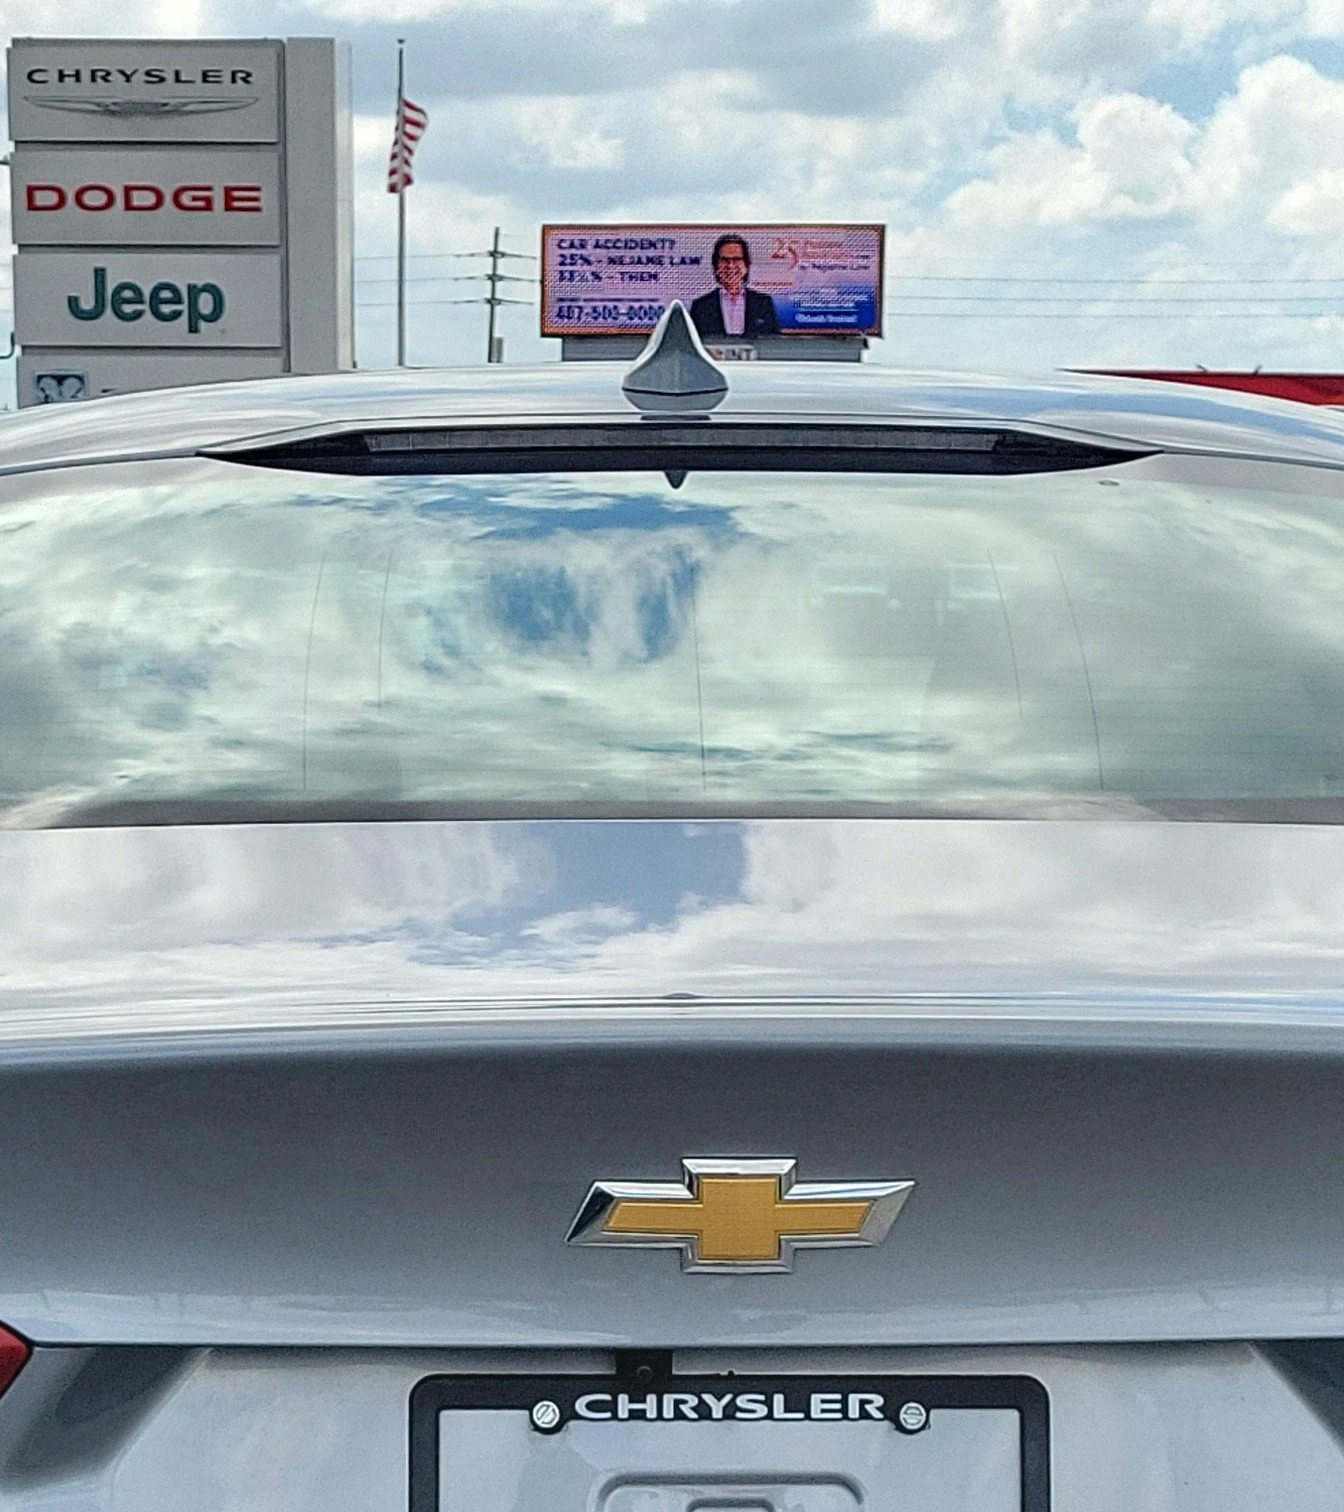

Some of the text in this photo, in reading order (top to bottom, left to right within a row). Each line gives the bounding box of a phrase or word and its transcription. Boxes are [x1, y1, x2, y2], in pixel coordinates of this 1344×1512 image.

[26, 68, 254, 85] CHRYSLER
[25, 184, 264, 212] DODGE
[557, 238, 588, 250] CAR
[558, 254, 592, 266] 25%
[67, 267, 225, 334] Jeep
[573, 1392, 886, 1420] CHRYSLER
